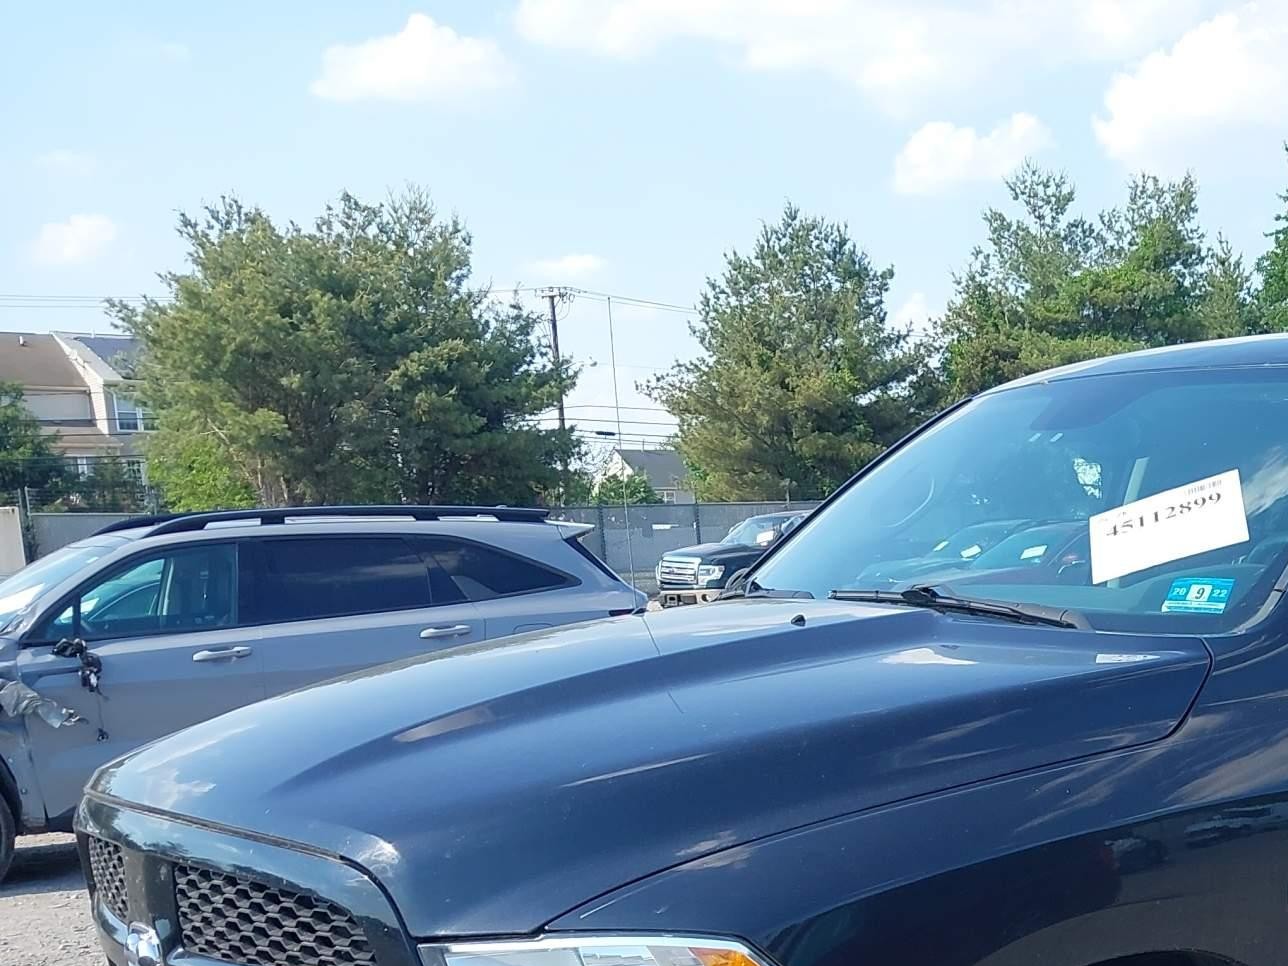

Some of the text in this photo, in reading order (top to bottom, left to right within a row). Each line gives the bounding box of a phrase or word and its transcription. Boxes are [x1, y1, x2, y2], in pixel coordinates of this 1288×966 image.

[1106, 492, 1222, 537] 45112899
[1172, 587, 1228, 600] 20 9 22
